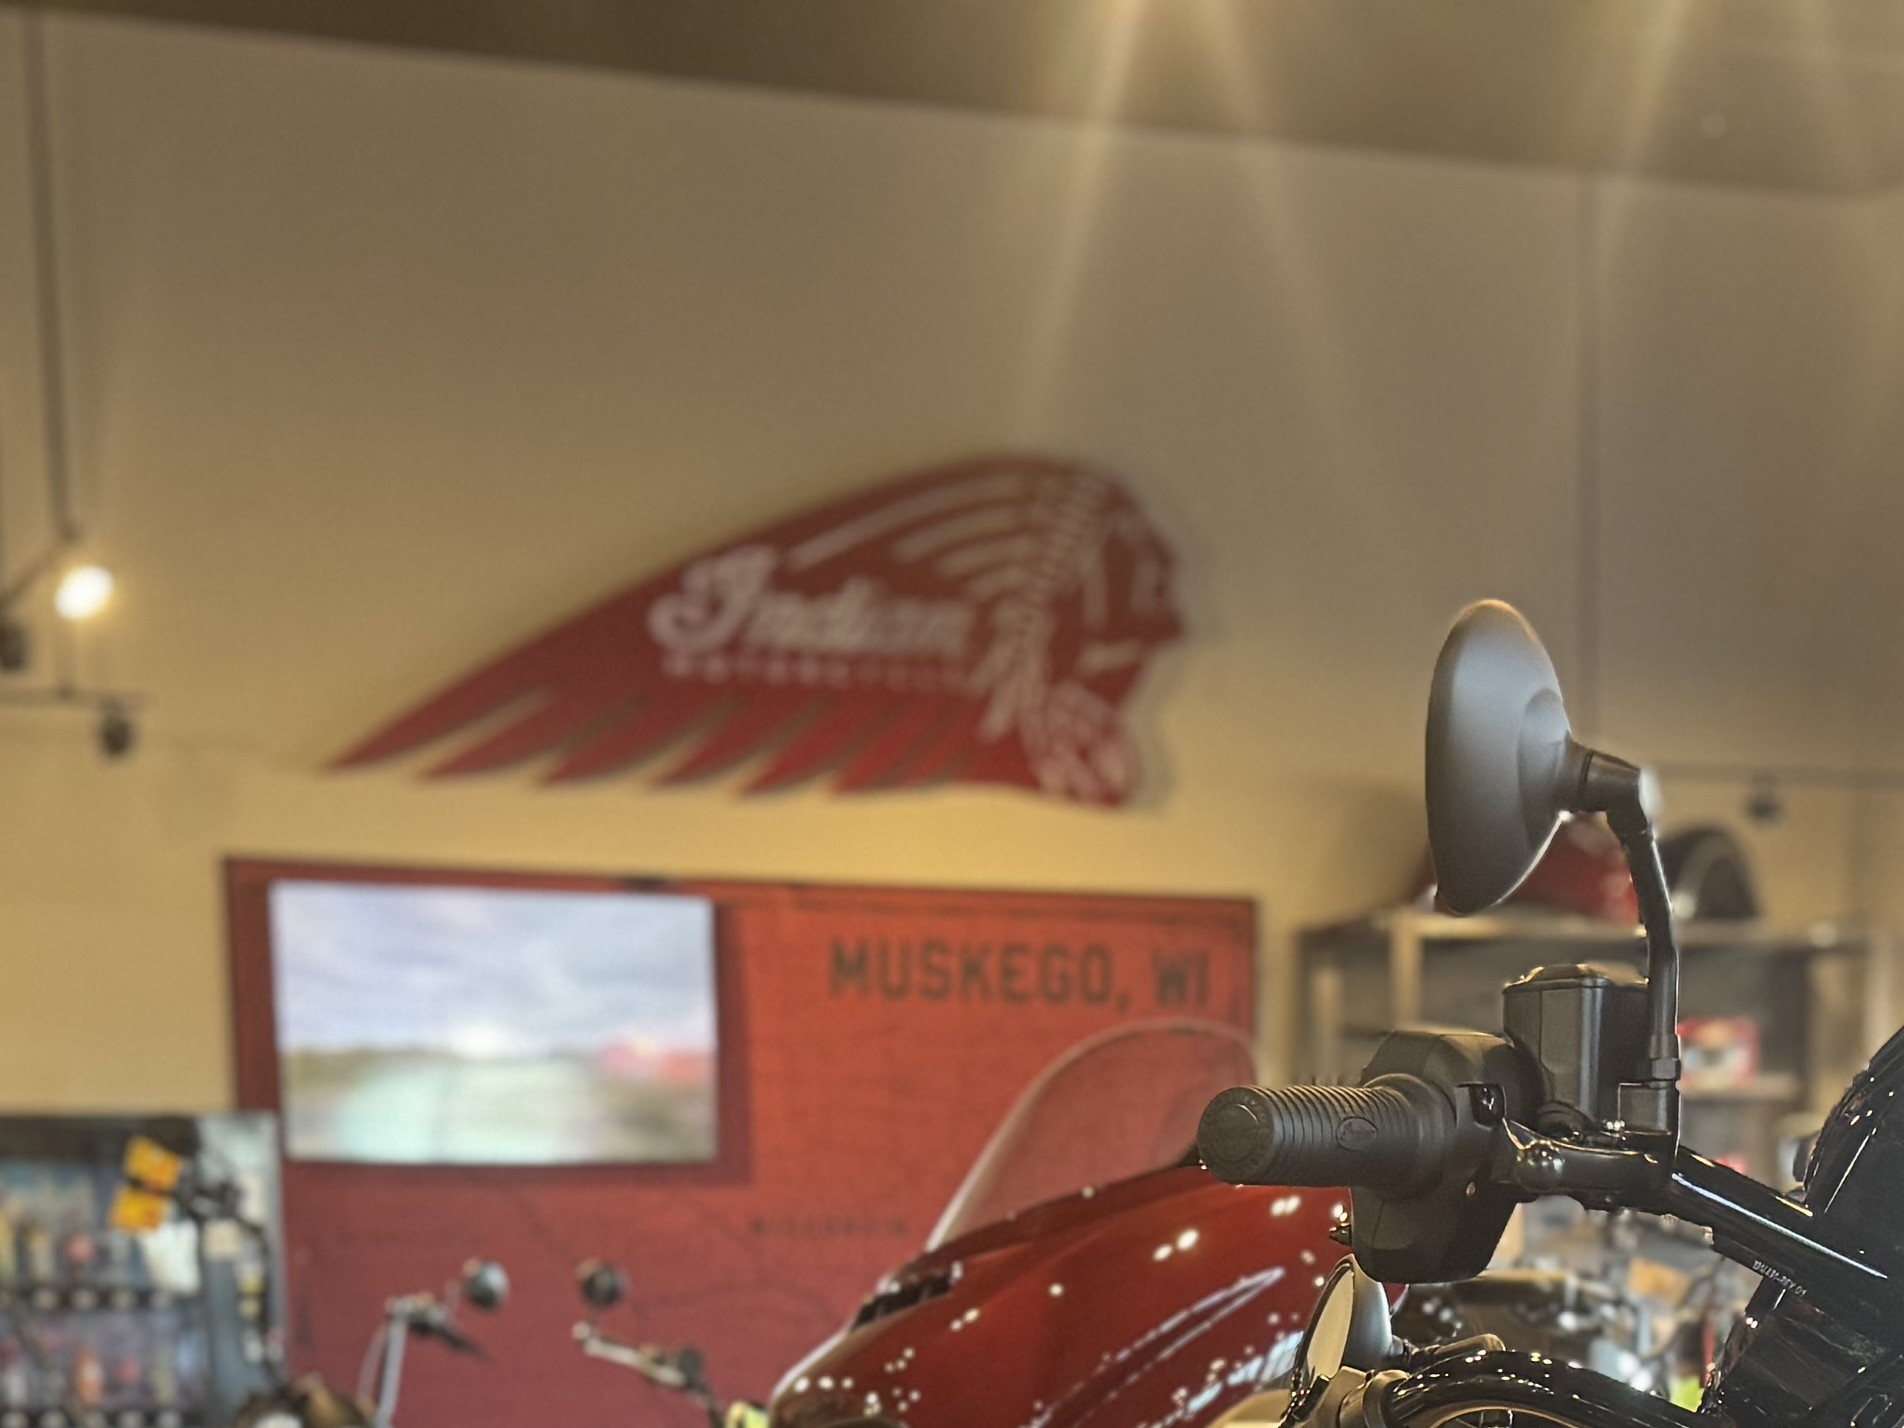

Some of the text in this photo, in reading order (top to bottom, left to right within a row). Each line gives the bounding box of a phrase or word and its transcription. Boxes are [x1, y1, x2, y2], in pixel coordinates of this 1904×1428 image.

[649, 545, 971, 654] Indian
[829, 938, 1210, 1013] MUSKEGO, WI
